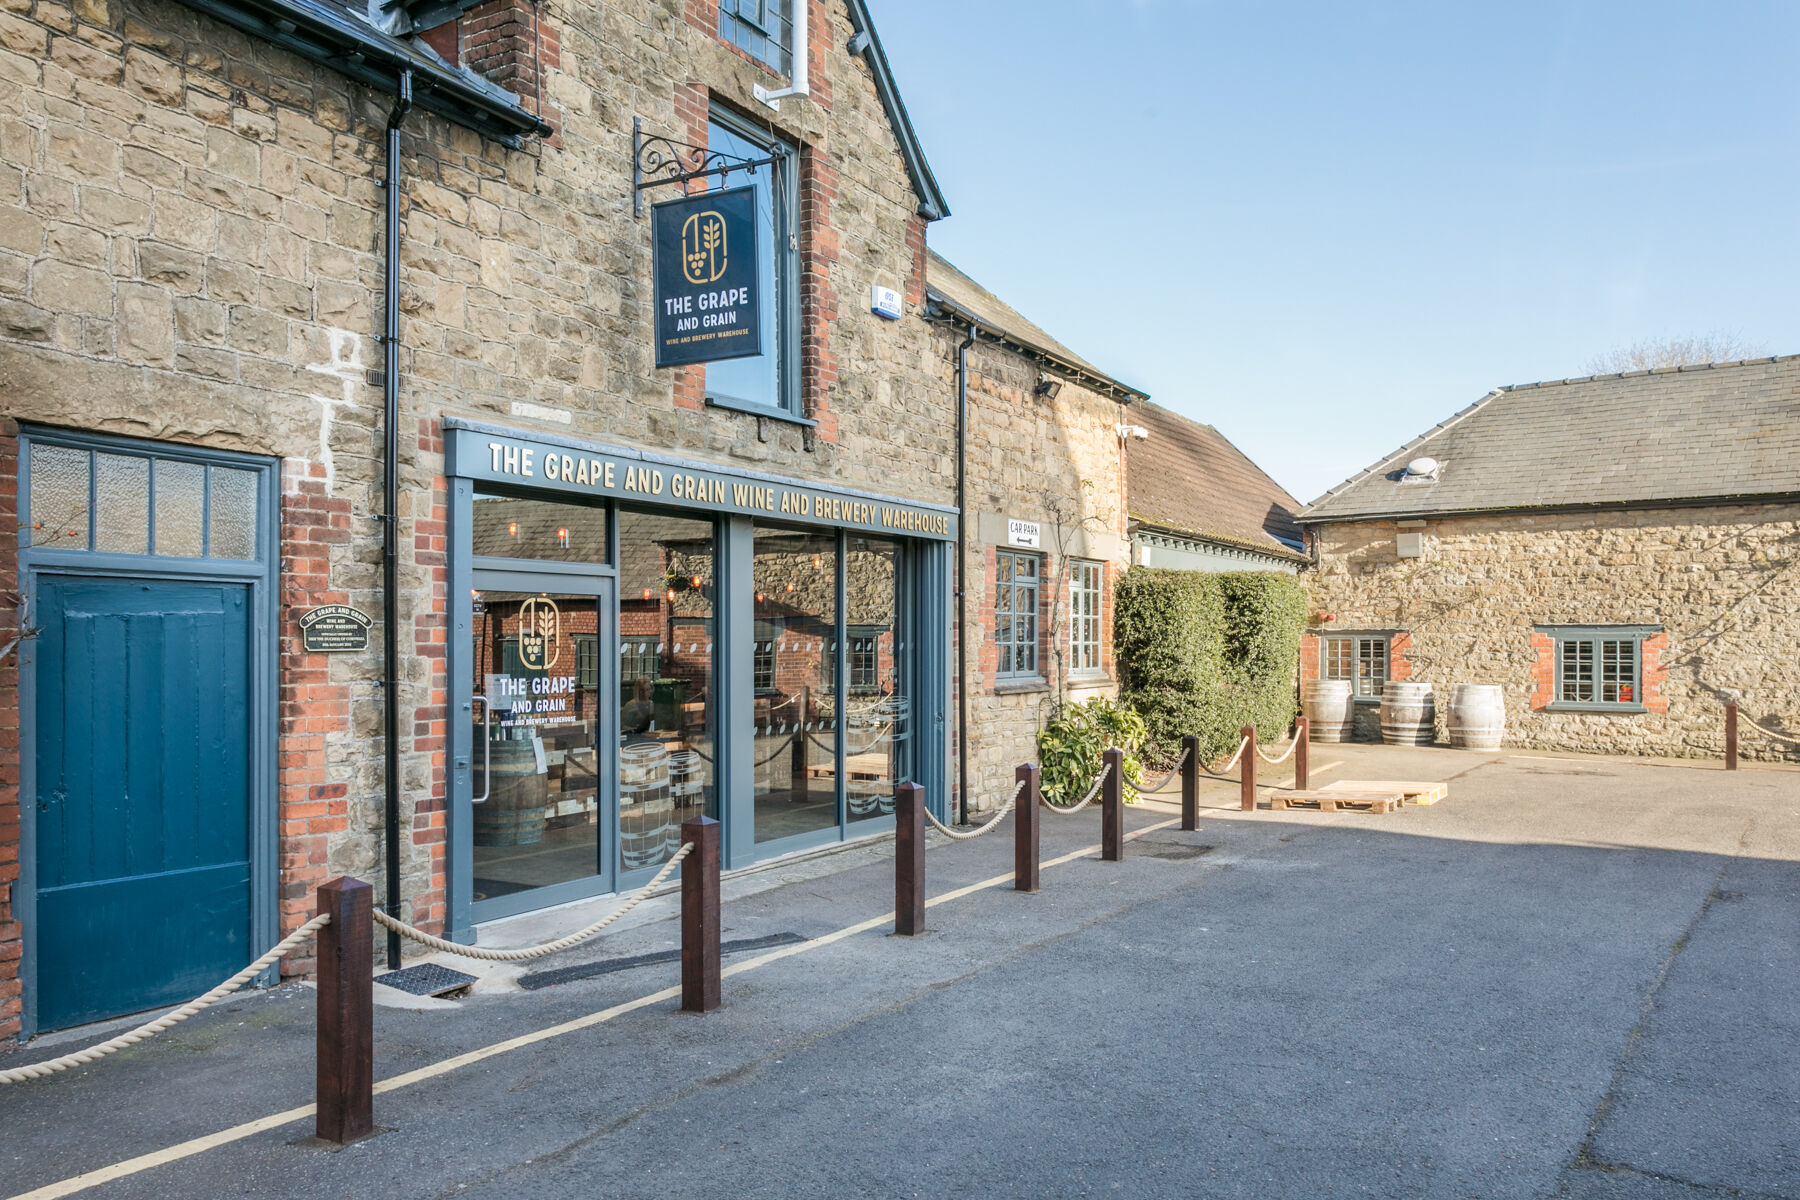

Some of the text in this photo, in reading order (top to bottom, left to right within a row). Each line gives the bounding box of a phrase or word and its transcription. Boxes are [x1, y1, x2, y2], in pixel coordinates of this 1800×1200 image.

[665, 287, 748, 316] THE GRAPE
[677, 311, 737, 332] AND GRAIN
[692, 333, 716, 342] BREWERY
[718, 328, 749, 338] WAREHOUSE
[489, 443, 949, 535] THE GRAPE AND GRAIN WINE AND BREWERY WAREHOUSE
[1010, 522, 1038, 536] CAR PARK
[305, 607, 368, 623] THE GRAPE AND GRAIN
[500, 676, 576, 696] THE GRAPE
[511, 698, 566, 714] AND GRAIN
[526, 717, 548, 725] BREWERY
[549, 715, 577, 723] WAREHOUSE
